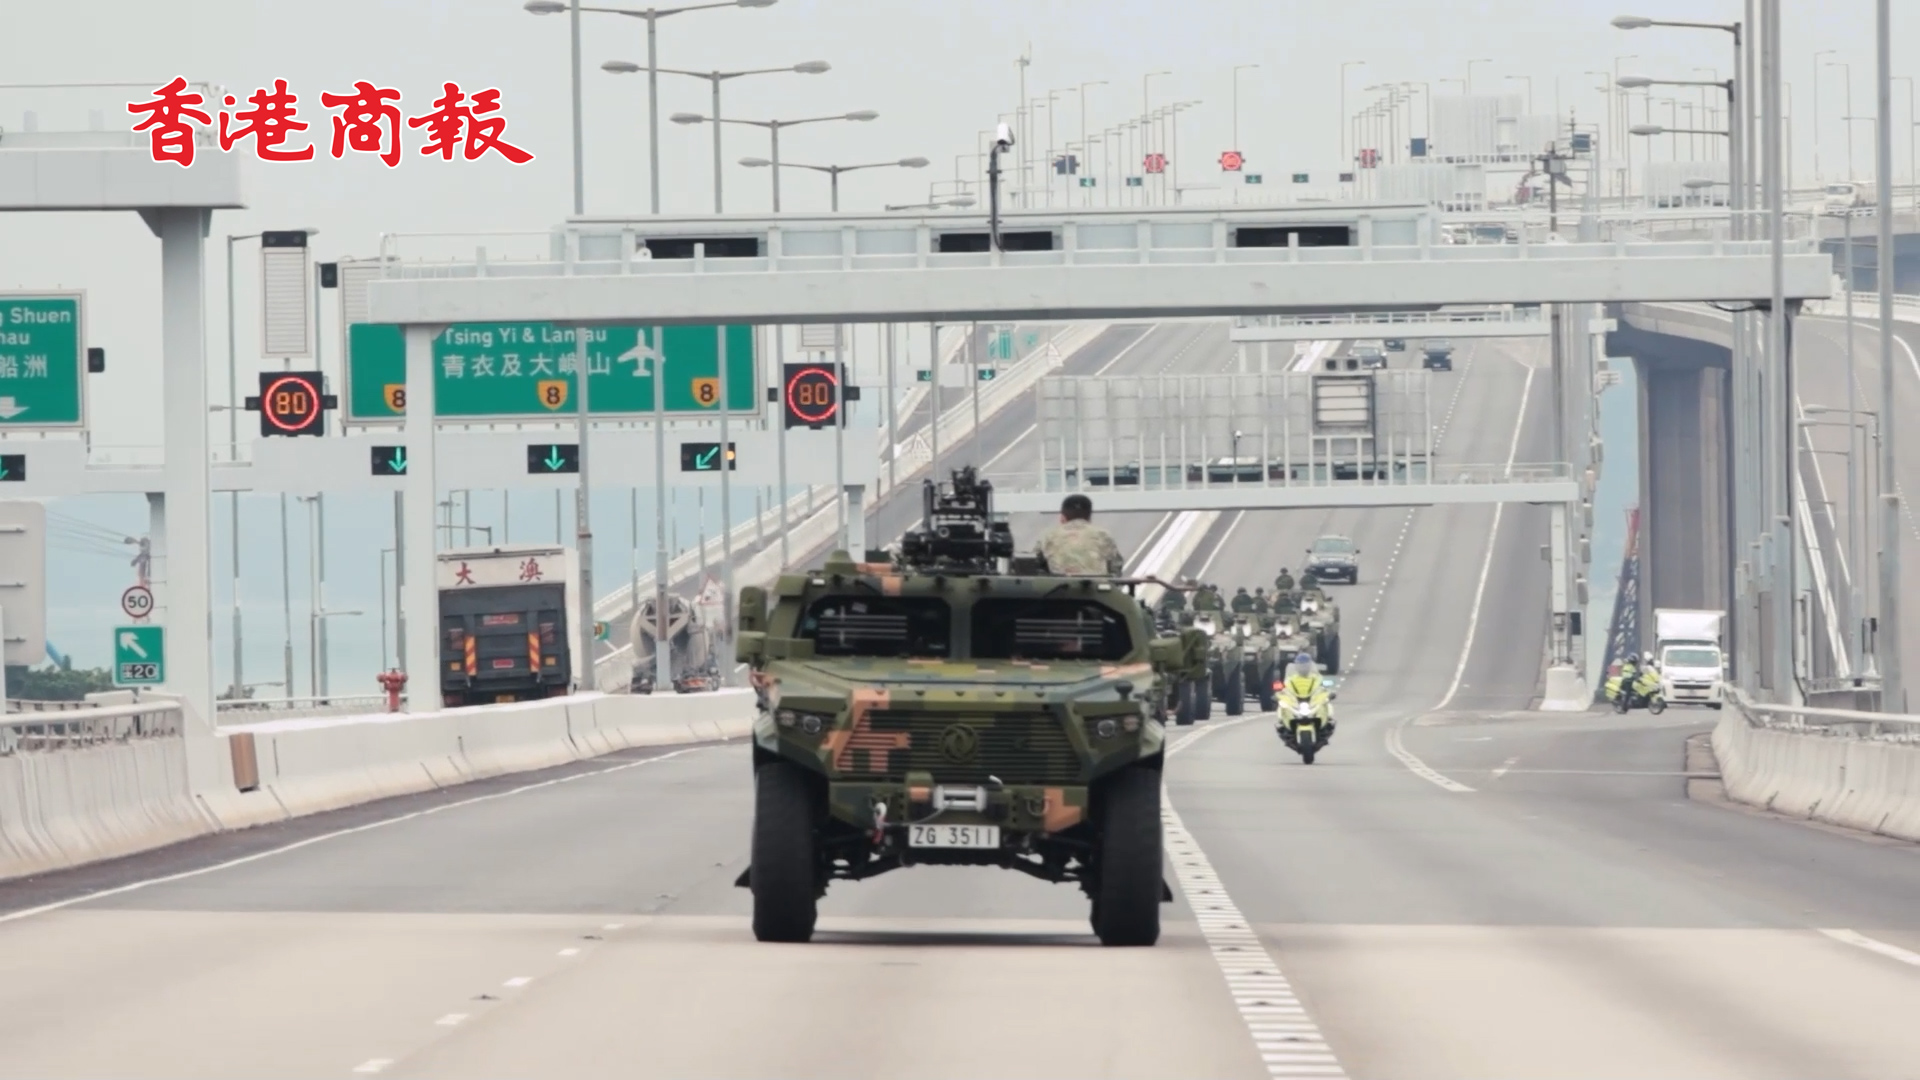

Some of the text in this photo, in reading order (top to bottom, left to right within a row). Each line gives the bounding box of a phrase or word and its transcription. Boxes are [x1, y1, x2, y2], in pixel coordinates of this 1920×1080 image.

[10, 306, 72, 324] Shuen
[499, 327, 517, 344] Yi
[522, 327, 535, 344] &
[542, 327, 608, 344] Lanau
[276, 391, 307, 415] 80
[392, 389, 406, 409] 8
[546, 386, 561, 406] 8
[699, 383, 714, 403] 8
[799, 382, 829, 406] 80
[127, 595, 149, 609] 50
[133, 664, 157, 679] 20
[914, 826, 993, 846] ZG 3511
